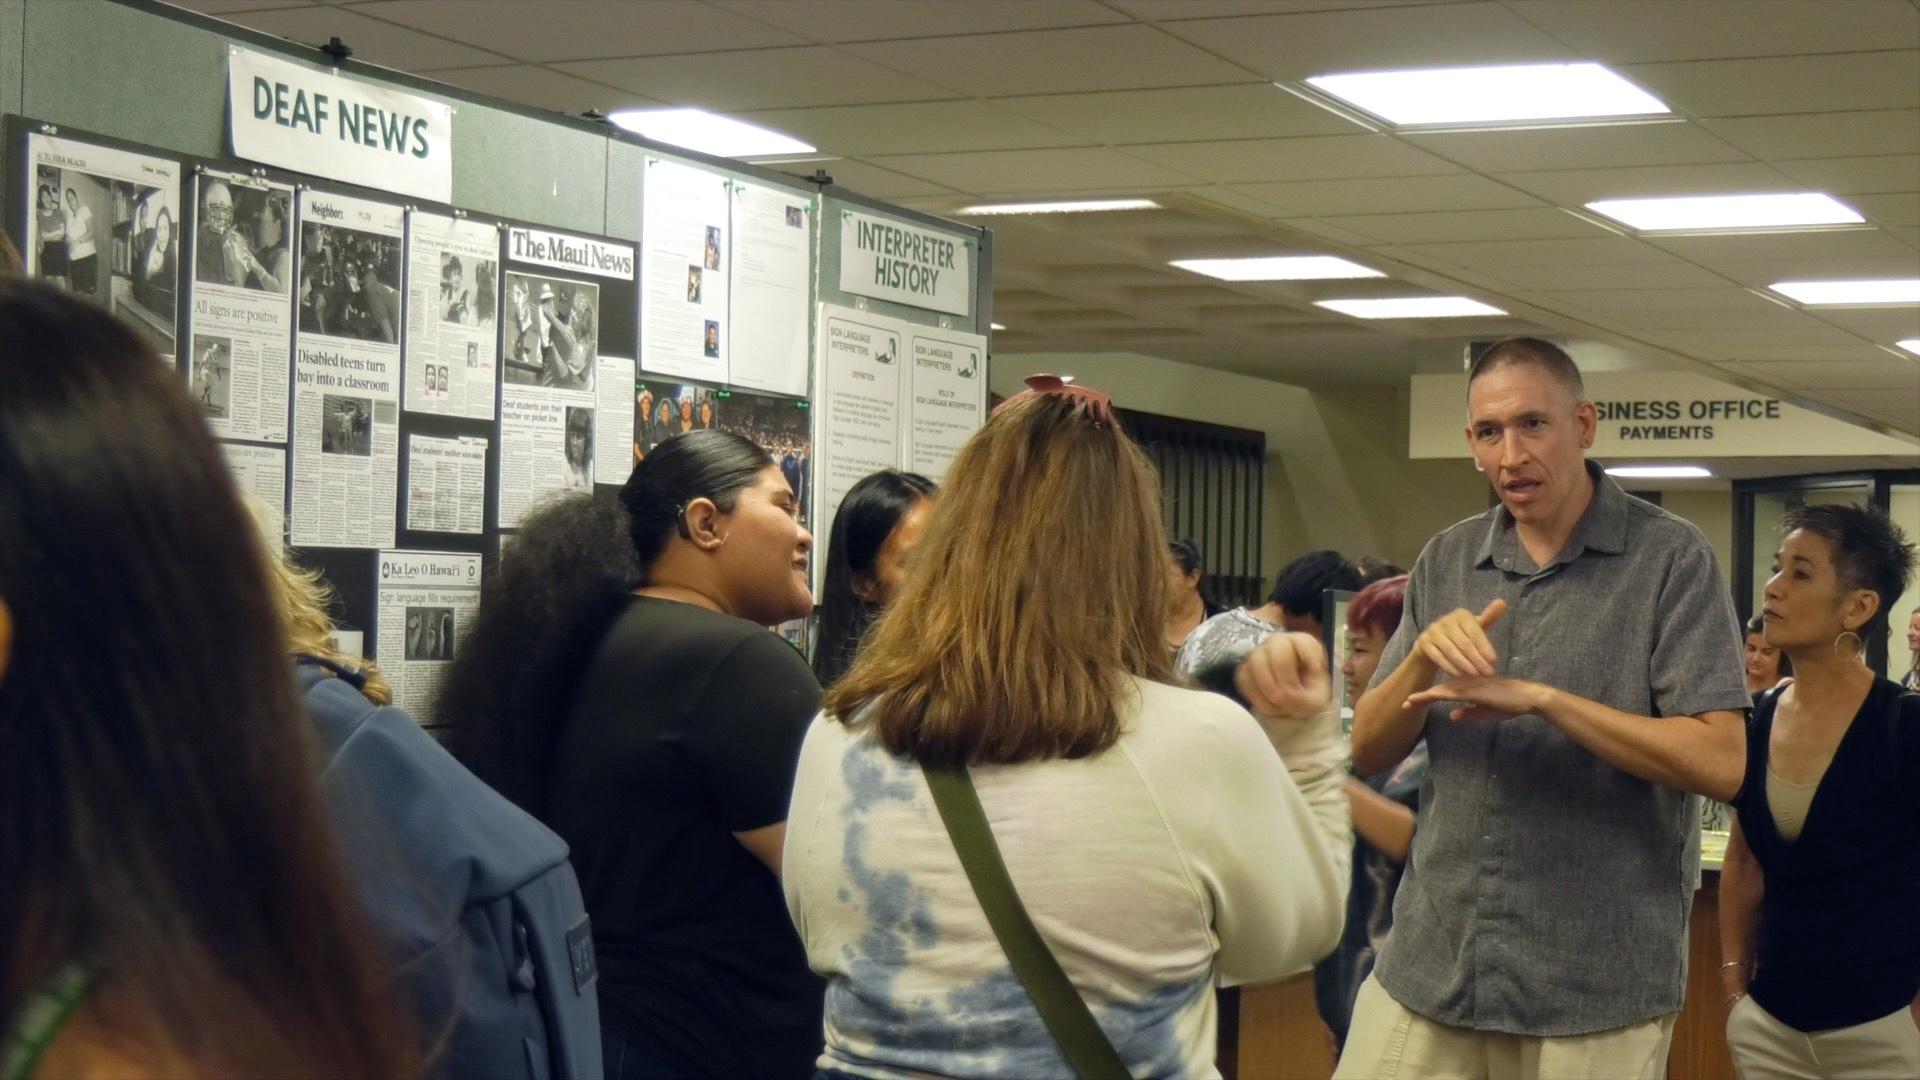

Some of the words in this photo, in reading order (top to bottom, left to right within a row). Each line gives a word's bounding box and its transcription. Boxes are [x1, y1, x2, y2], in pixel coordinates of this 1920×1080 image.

[254, 76, 328, 134] DEAF
[339, 99, 429, 159] NEWS
[311, 200, 344, 220] Neighbors
[512, 230, 545, 258] The
[548, 237, 588, 267] Maui
[591, 245, 632, 274] News
[857, 219, 954, 270] INTERPRETER
[875, 256, 939, 296] HISTORY
[195, 299, 208, 313] All
[209, 303, 230, 320] signs
[232, 309, 246, 320] are
[247, 309, 279, 324] positive
[830, 327, 843, 337] SIGN
[844, 329, 871, 344] LANGUAGE
[831, 340, 869, 356] INTERPRETERS
[915, 345, 927, 354] SIGN
[928, 347, 953, 360] LANGUAGE
[298, 349, 338, 367] Disabled
[340, 356, 364, 370] teens
[366, 360, 386, 373] turn
[916, 358, 952, 371] INTERPRETERS
[297, 368, 313, 387] bay
[316, 371, 335, 386] into
[337, 376, 343, 387] a
[344, 374, 389, 392] classroom
[503, 400, 515, 409] Deaf
[516, 401, 539, 411] students
[1596, 400, 1680, 420] SINESS
[1689, 399, 1780, 420] OFFICE
[1620, 426, 1714, 440] PAYMENTS
[391, 562, 402, 574] Ka
[405, 563, 419, 575] Leo
[422, 563, 428, 575] O
[380, 591, 395, 604] Sign
[396, 592, 426, 605] language
[428, 592, 438, 603] fills
[440, 594, 478, 605] requirement
